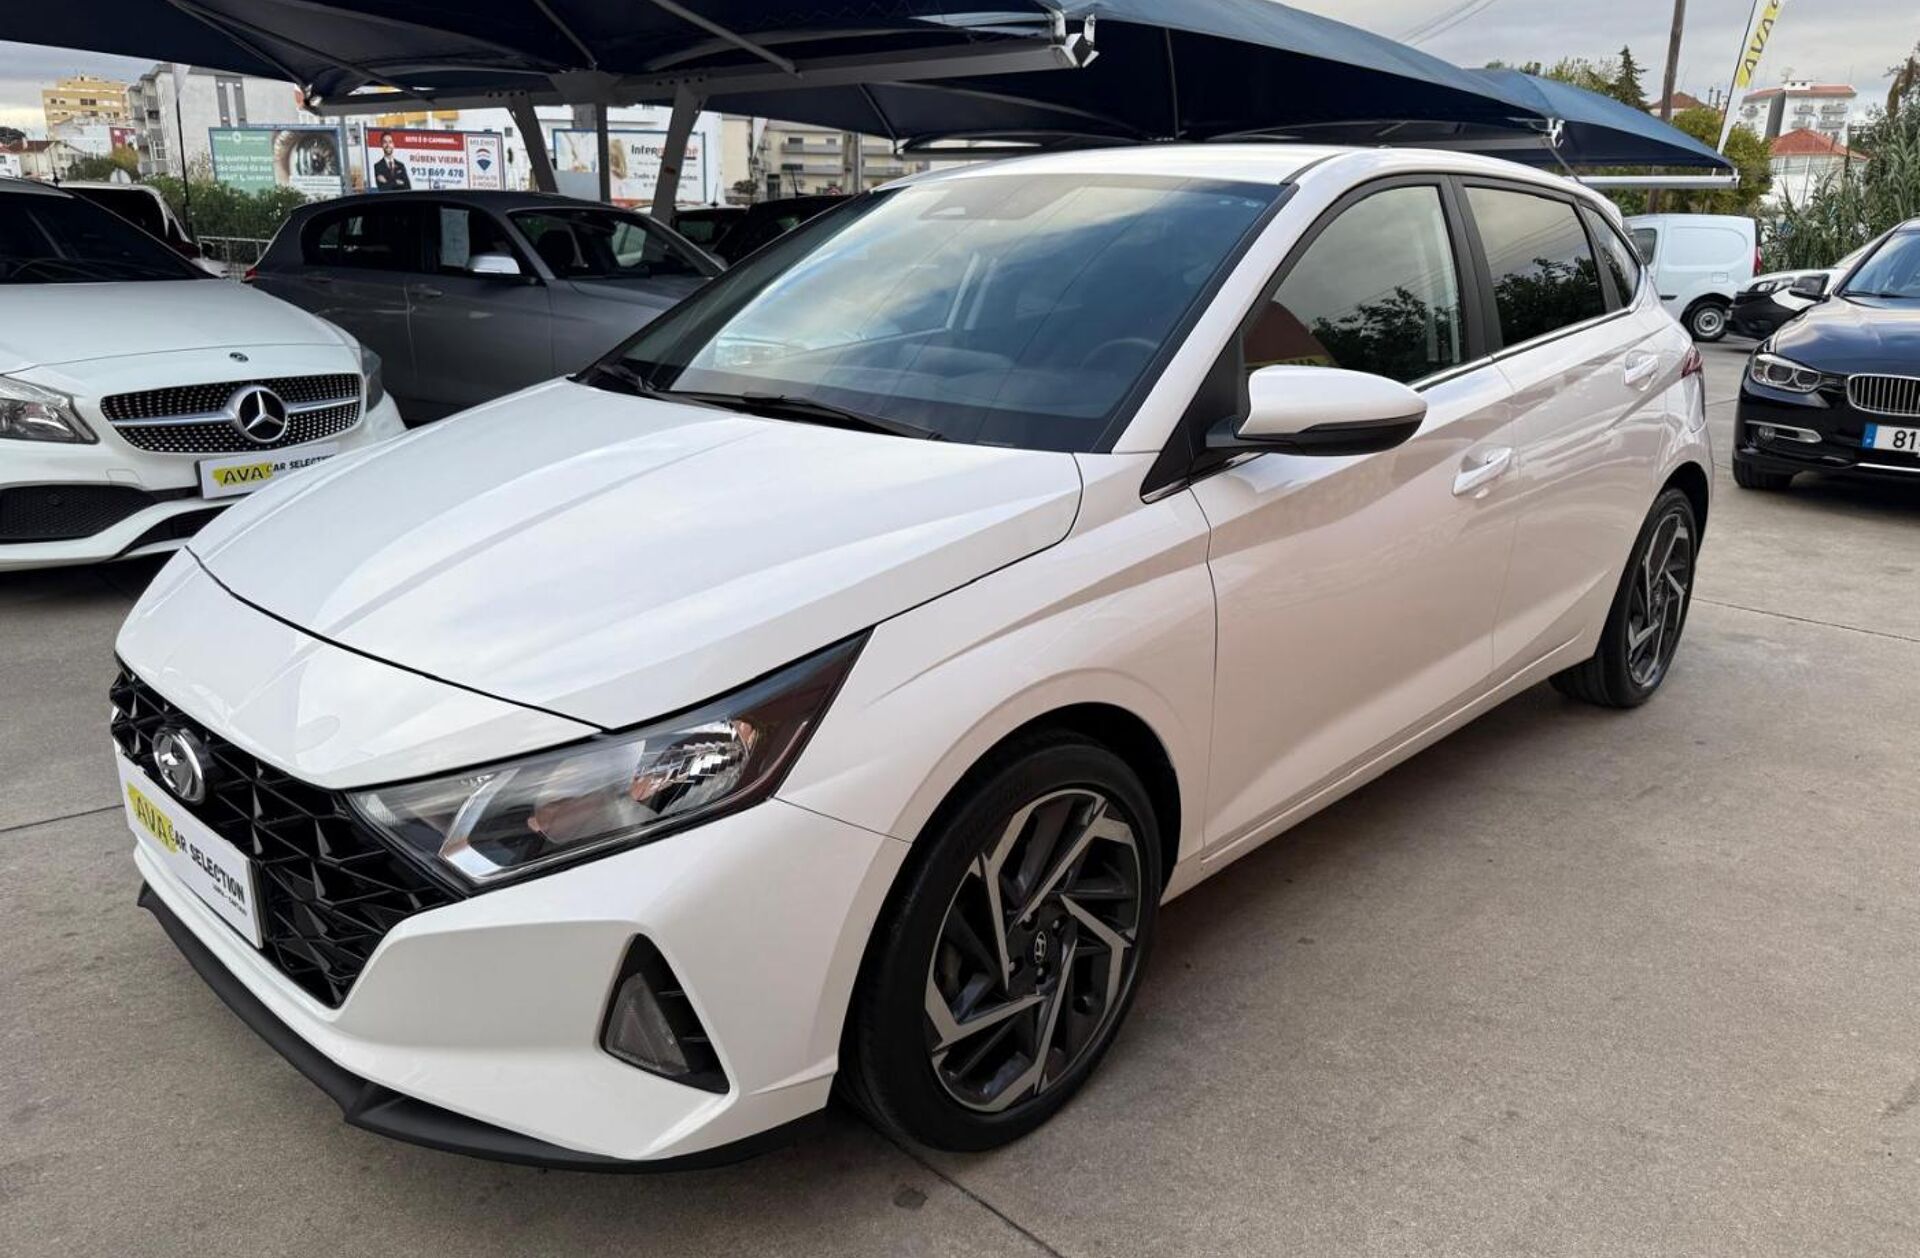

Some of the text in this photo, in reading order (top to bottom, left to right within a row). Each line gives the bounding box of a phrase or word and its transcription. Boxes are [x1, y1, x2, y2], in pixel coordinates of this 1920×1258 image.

[438, 156, 464, 164] VIEIRA
[411, 167, 427, 176] 913
[223, 467, 264, 484] AVA
[266, 462, 286, 473] CAR
[134, 797, 169, 847] AVA
[167, 820, 188, 855] CAR
[189, 843, 247, 905] SELECTION
